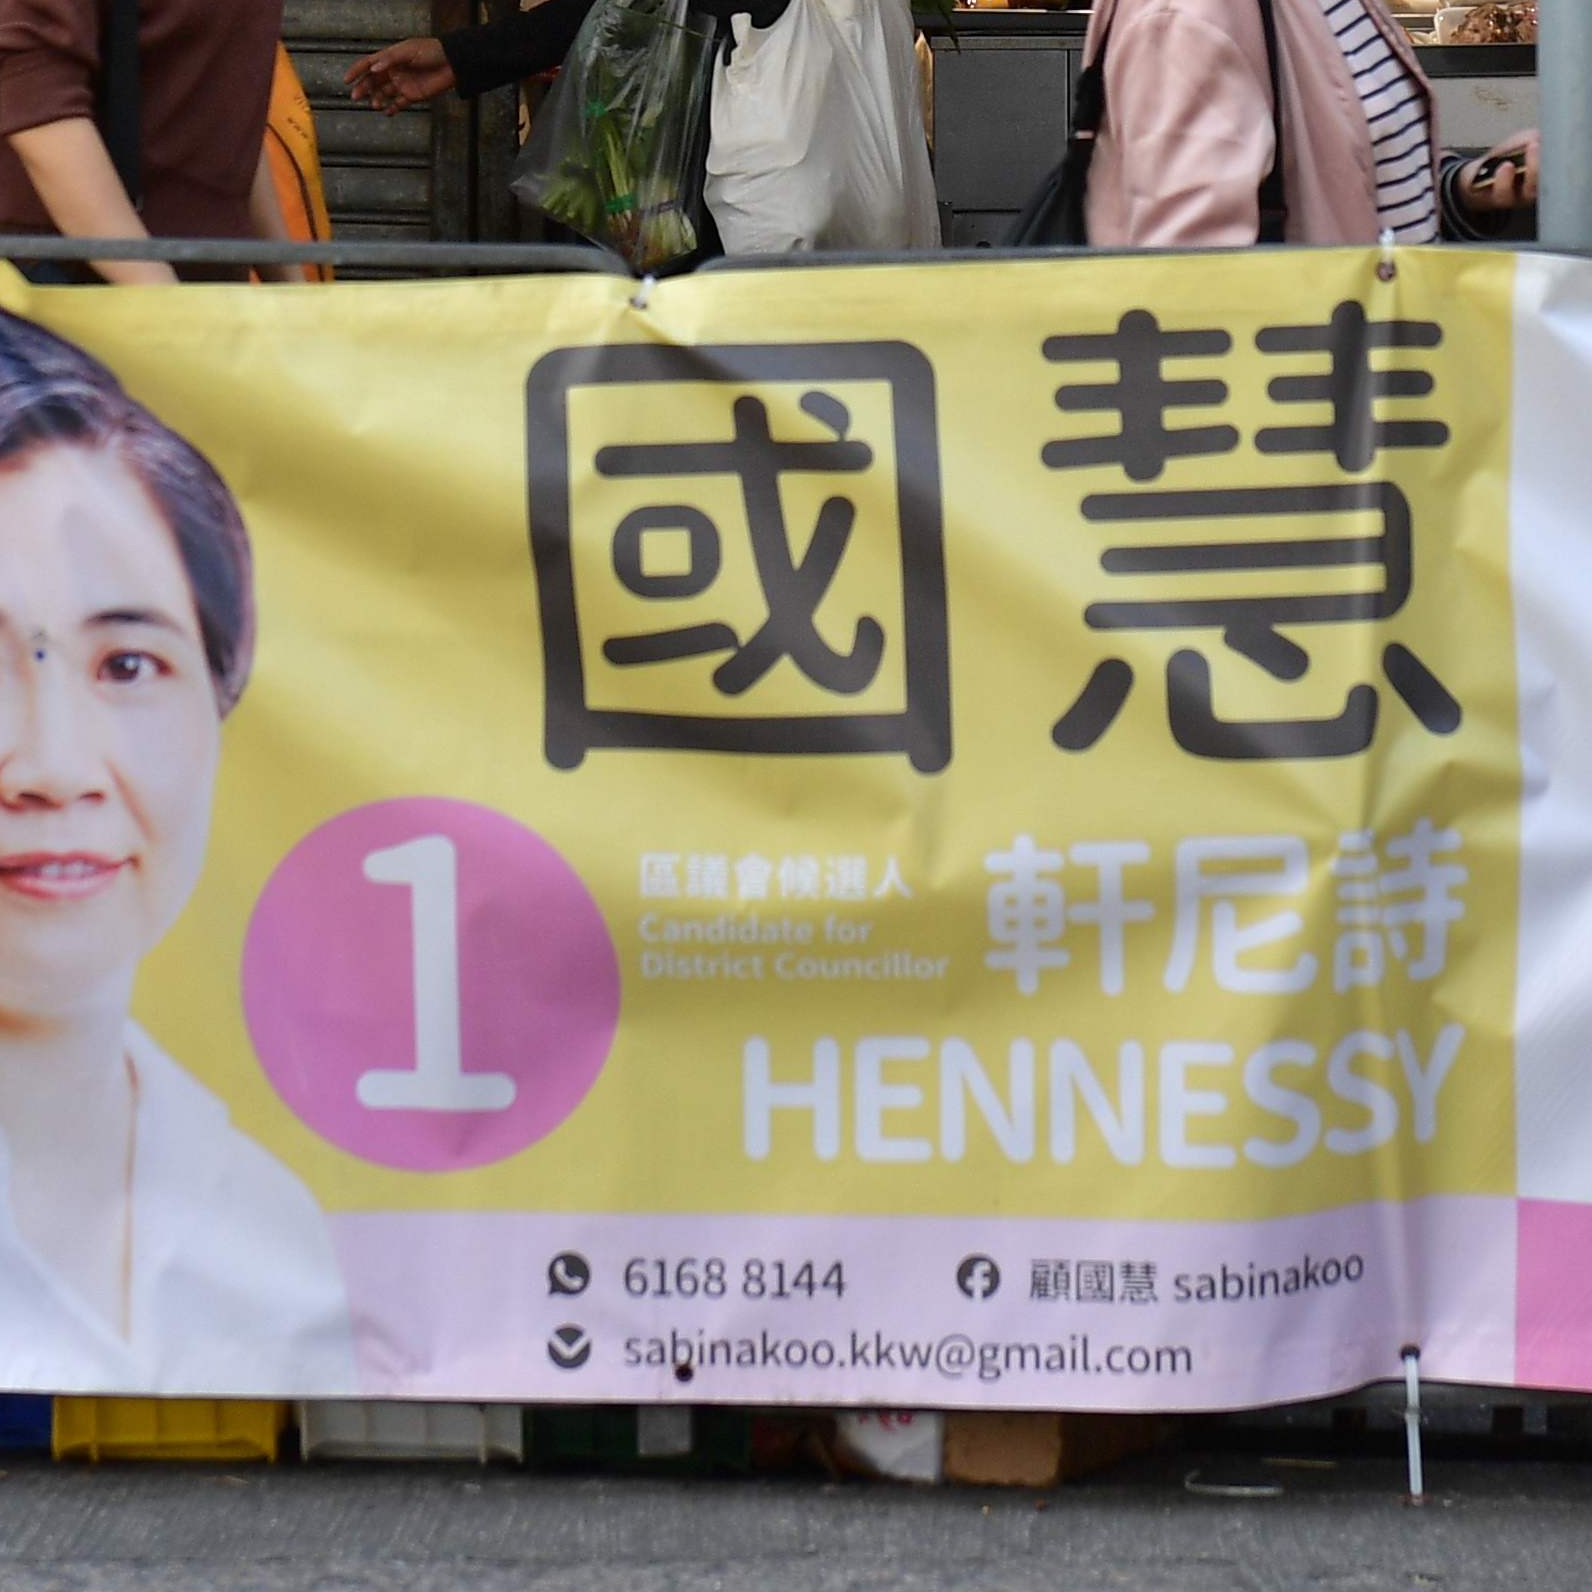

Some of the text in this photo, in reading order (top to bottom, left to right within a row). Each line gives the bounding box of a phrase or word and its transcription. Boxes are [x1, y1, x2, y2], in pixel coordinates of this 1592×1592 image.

[639, 851, 912, 901] 區議會候選人
[638, 911, 874, 944] Candidate for
[983, 817, 1469, 999] 軒尼詩
[357, 835, 516, 1113] 1
[640, 950, 951, 981] District Councillor
[741, 1022, 1467, 1170] HENNESSY
[624, 1258, 846, 1300] 6168 8144
[1029, 1254, 1365, 1304] 顧國慧 sabinakoo
[624, 1329, 1193, 1382] sabinakoo.kkw@gmail.com
